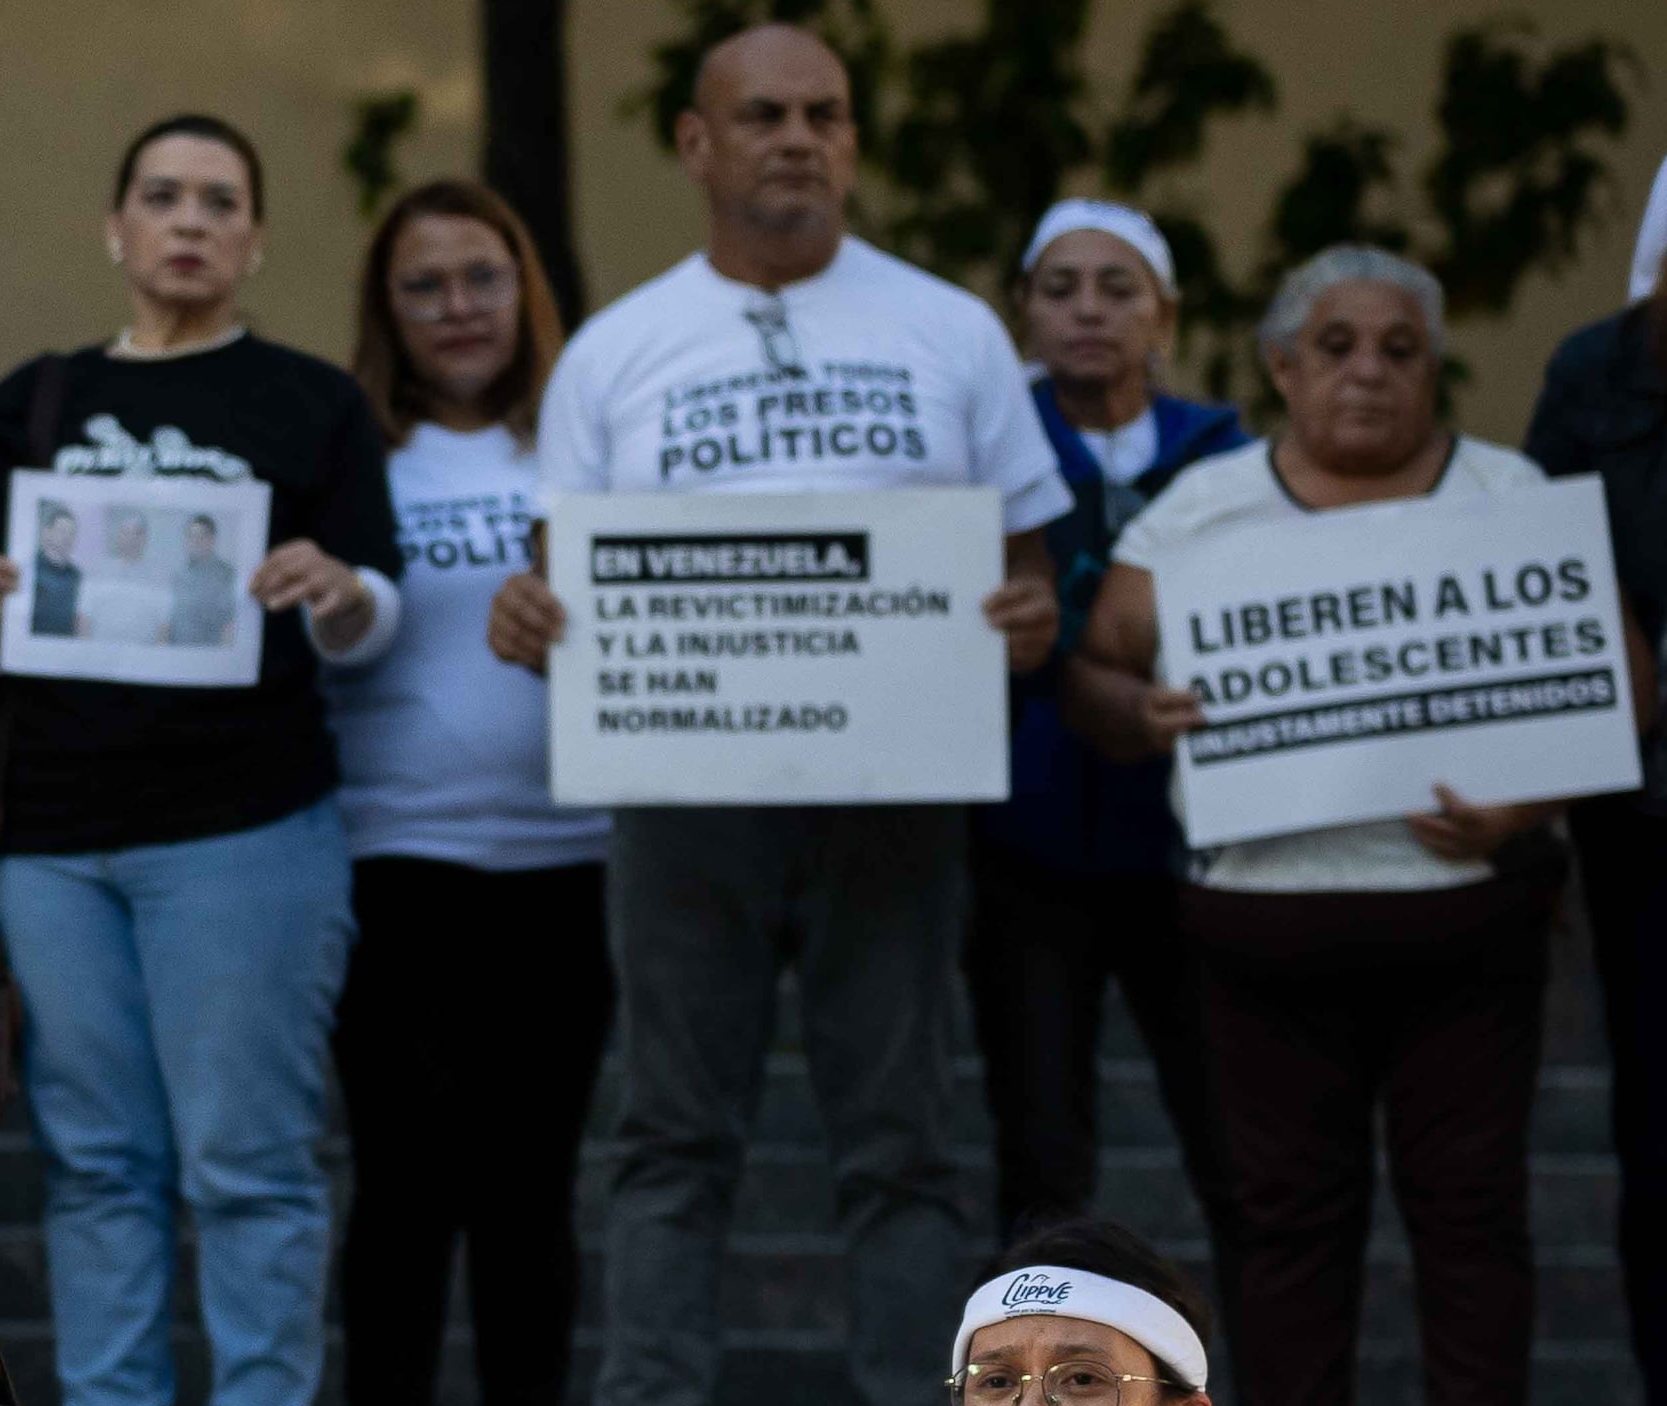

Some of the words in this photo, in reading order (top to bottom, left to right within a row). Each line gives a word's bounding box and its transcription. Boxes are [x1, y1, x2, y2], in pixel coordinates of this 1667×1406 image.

[757, 390, 919, 434] PRESOS
[661, 418, 927, 481] POLÍTICOS
[599, 542, 635, 577] EN
[596, 592, 639, 621] LA
[647, 585, 951, 622] REVICTIMIZACIÓN
[1189, 581, 1419, 656] LIBEREN
[1433, 575, 1474, 618] A
[1482, 557, 1593, 606] LOS
[597, 630, 618, 659] Y
[624, 630, 668, 659] LA
[677, 628, 860, 659] INJUSTICIA
[1187, 619, 1608, 705] ADOLESCENTES
[597, 668, 637, 696] SE
[648, 668, 717, 697] HAN
[597, 703, 850, 735] NORMALIZADO
